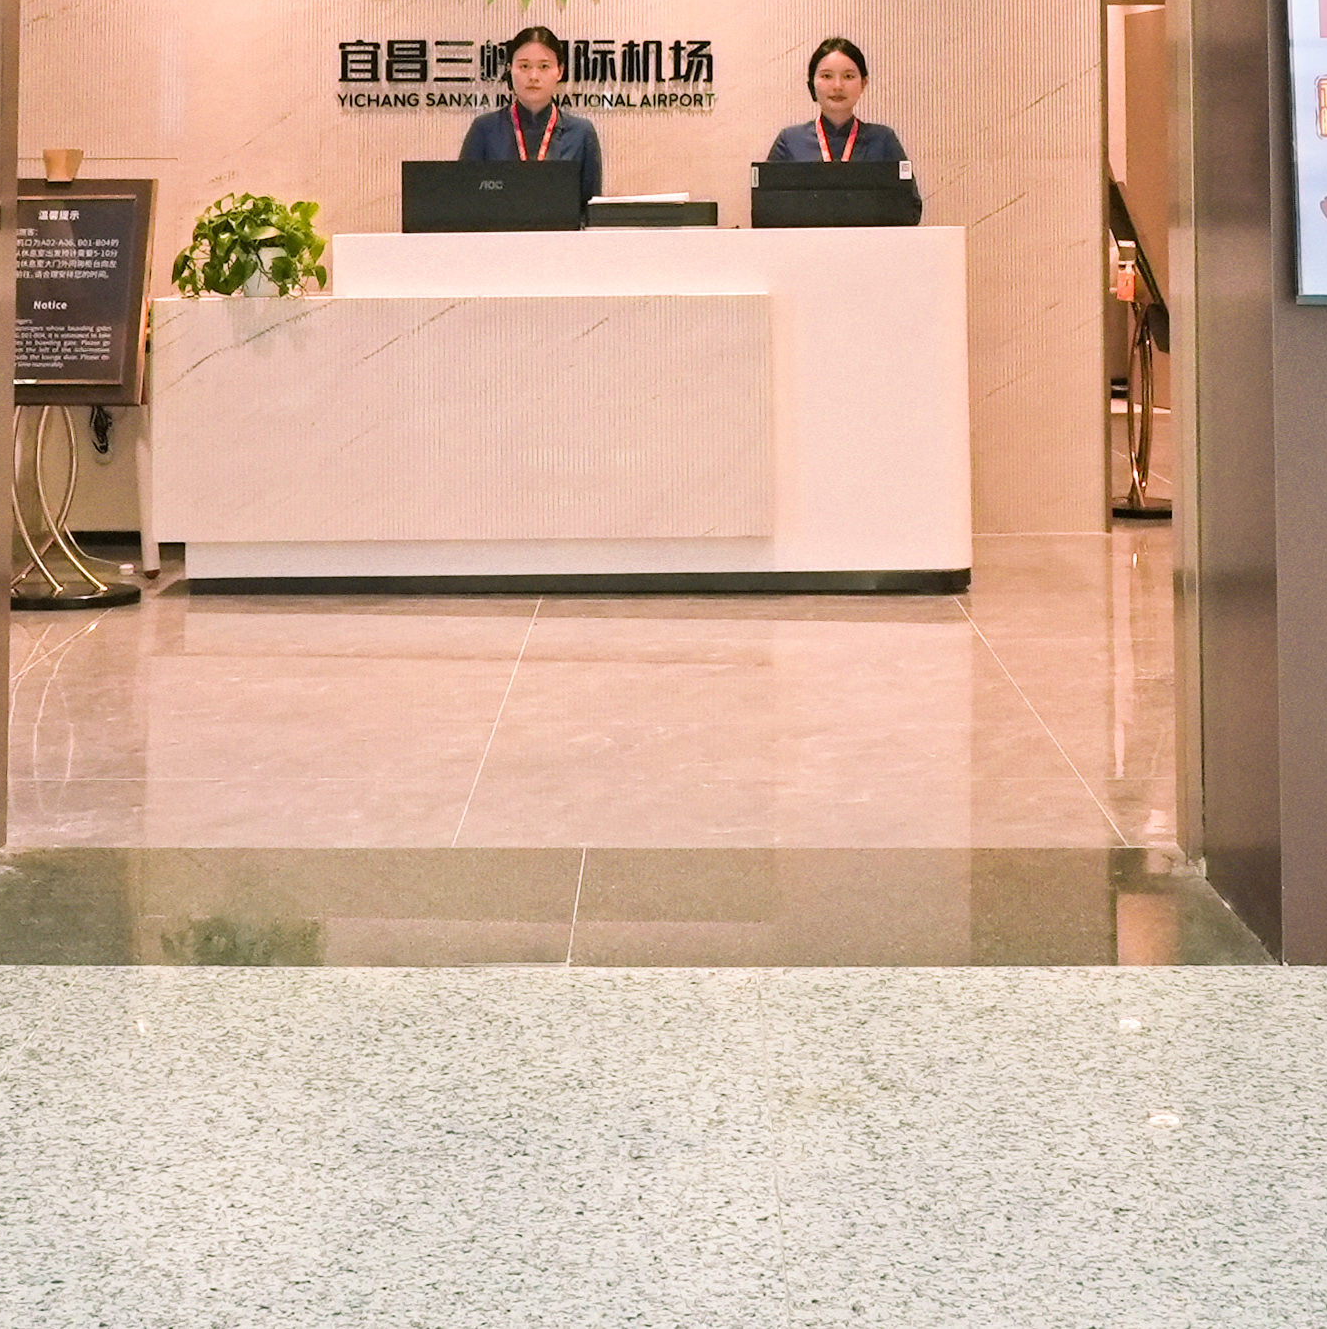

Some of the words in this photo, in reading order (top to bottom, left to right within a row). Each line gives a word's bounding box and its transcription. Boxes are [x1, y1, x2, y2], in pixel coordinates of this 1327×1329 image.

[338, 39, 714, 83] 宜昌三峡际机场
[337, 92, 420, 108] YICHANG
[425, 92, 489, 108] SANXIA
[495, 92, 636, 108] INNATIONAL
[639, 92, 716, 108] AIRPORT
[33, 300, 68, 310] Notice
